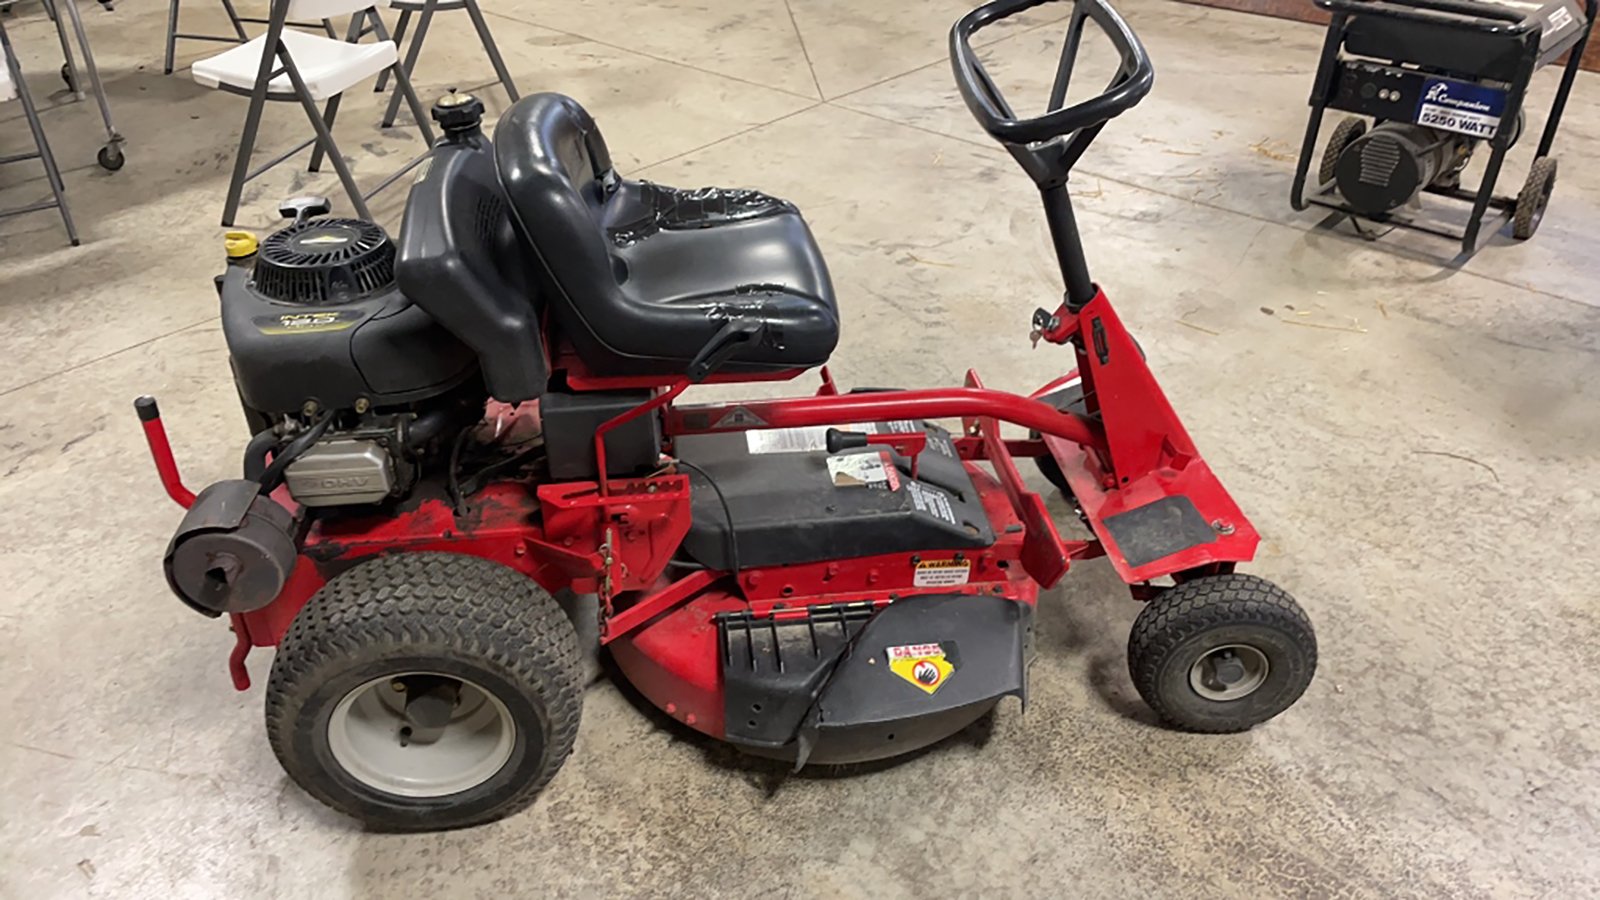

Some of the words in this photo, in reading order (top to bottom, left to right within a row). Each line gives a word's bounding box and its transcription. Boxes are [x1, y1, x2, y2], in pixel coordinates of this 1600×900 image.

[1438, 94, 1490, 111] Companion
[1422, 113, 1456, 127] 5250
[1459, 119, 1497, 135] WATT
[929, 560, 968, 568] WARNING
